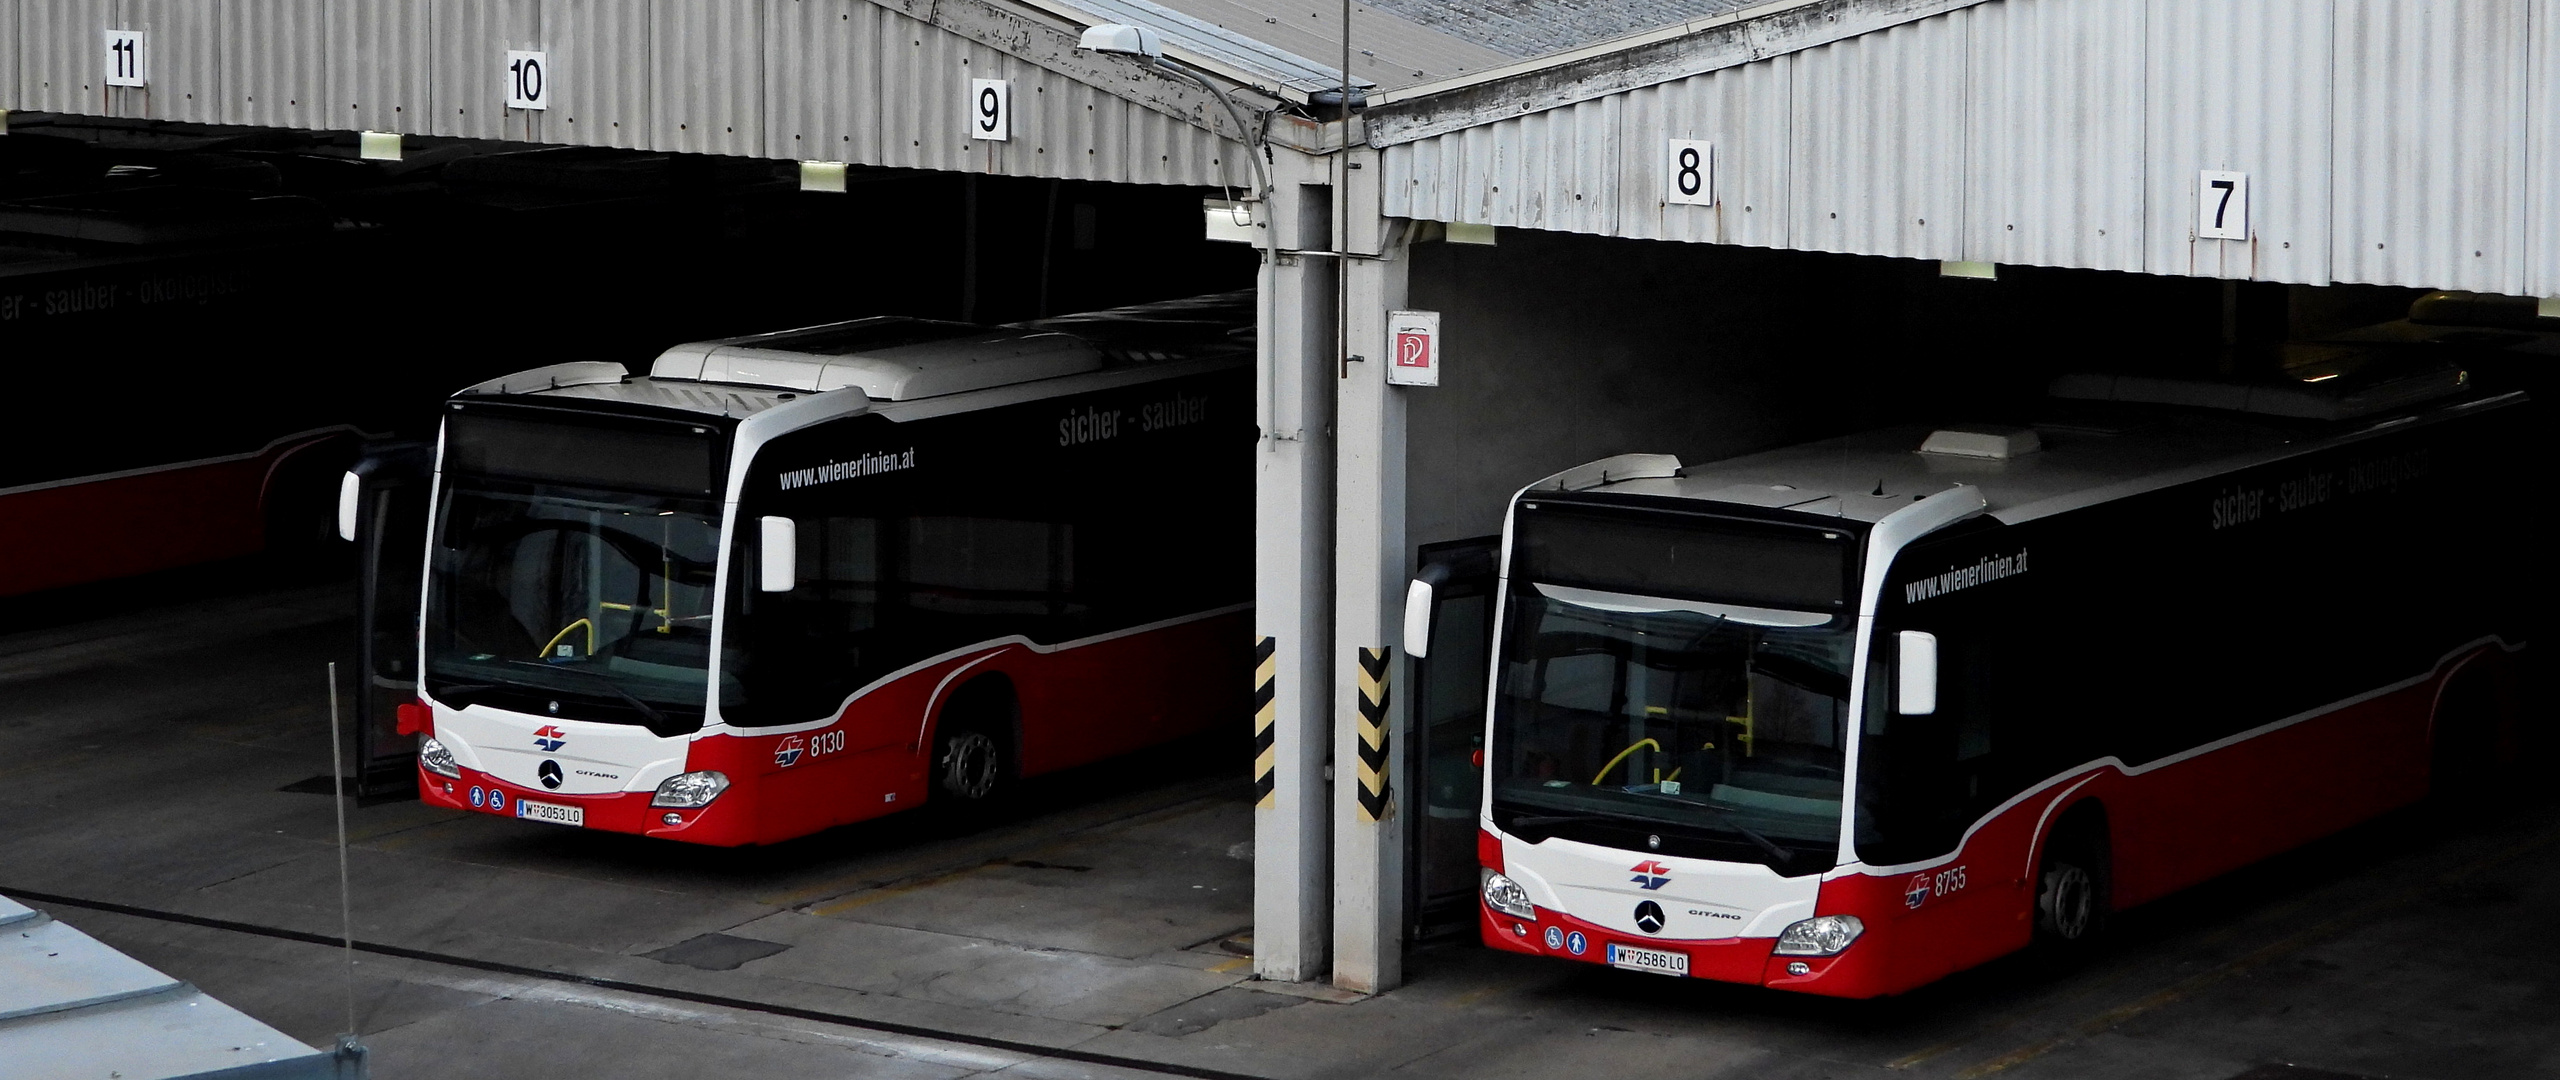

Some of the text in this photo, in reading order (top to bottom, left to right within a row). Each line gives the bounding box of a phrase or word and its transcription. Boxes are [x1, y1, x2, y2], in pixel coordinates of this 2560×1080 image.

[112, 38, 134, 79] 11
[511, 58, 542, 102] 10
[979, 87, 999, 133] 9
[1678, 147, 1701, 197] 8
[2211, 180, 2235, 229] 7
[45, 280, 118, 316] sauber
[1059, 405, 1121, 447] sicher
[1142, 390, 1208, 432] sauber
[779, 446, 915, 491] www.wienerlinien.at
[2212, 484, 2265, 530] sicher
[2279, 467, 2334, 513] sauber
[2349, 448, 2429, 494] ökologisch
[1905, 546, 2028, 605] www.wienerlinien.at
[810, 729, 845, 757] 8130
[575, 769, 619, 780] CITARO
[525, 802, 534, 816] W
[1934, 864, 1967, 897] 8755
[1688, 908, 1742, 921] CITARO
[1617, 947, 1627, 963] W
